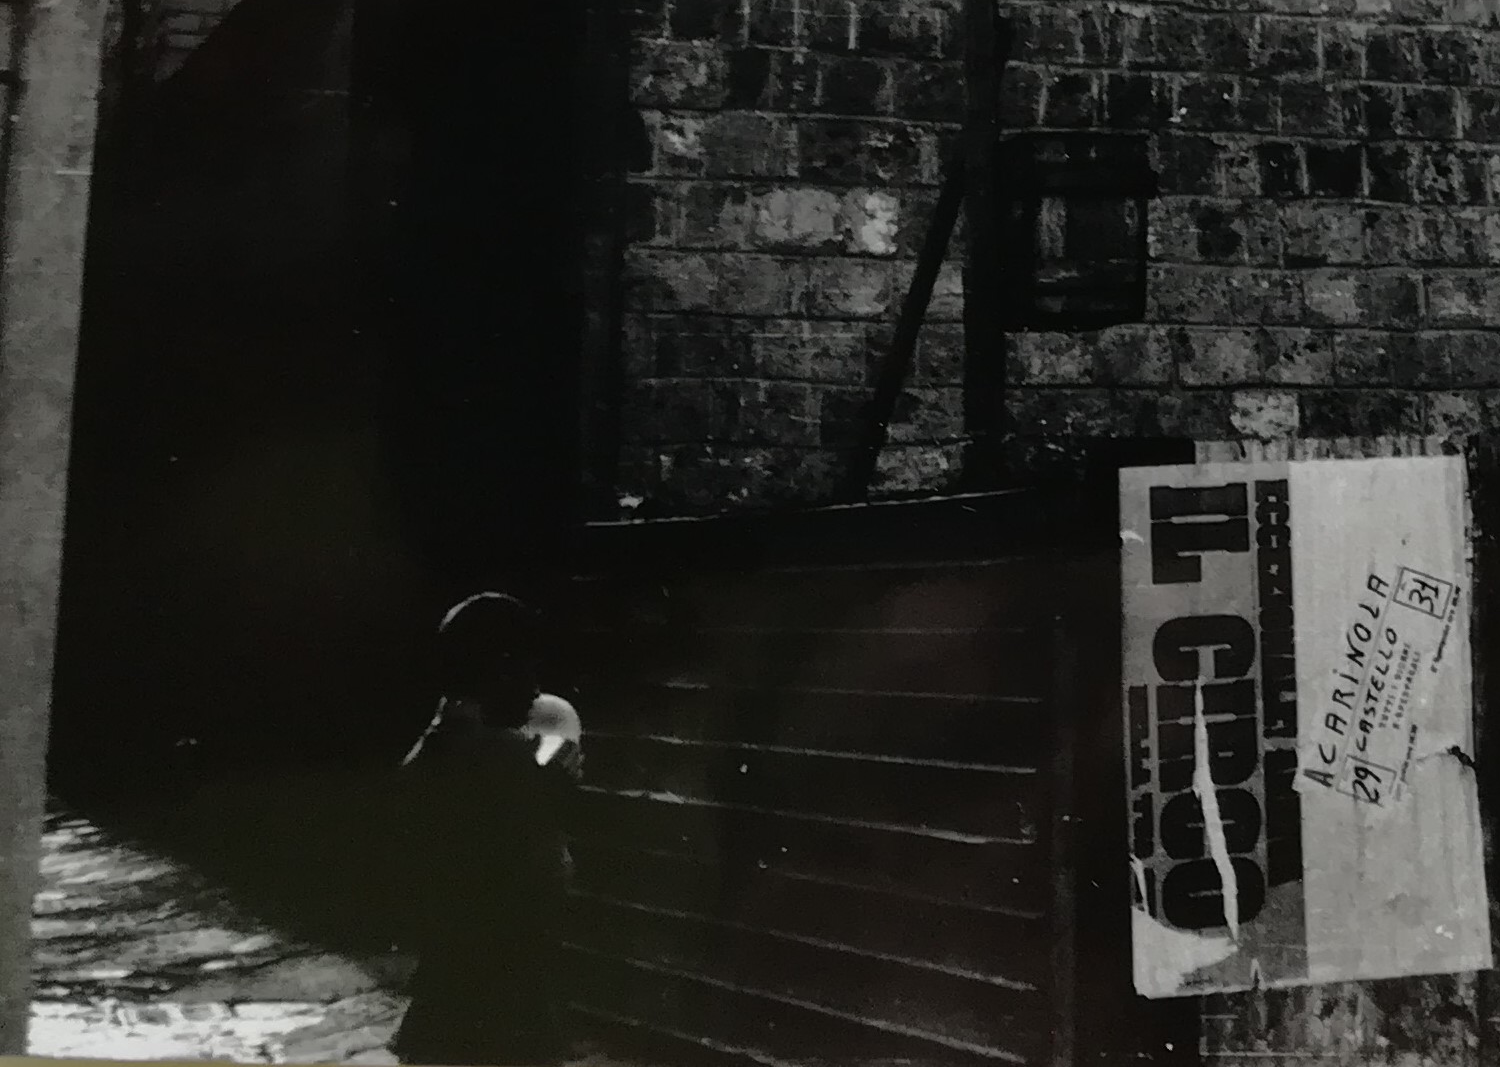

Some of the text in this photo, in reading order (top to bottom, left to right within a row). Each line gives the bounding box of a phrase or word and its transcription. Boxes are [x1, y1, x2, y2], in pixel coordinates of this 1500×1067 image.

[1407, 577, 1440, 615] 31
[1149, 482, 1266, 929] IL CIRCO
[1355, 627, 1398, 753] CASTELLO
[1351, 765, 1384, 808] 29
